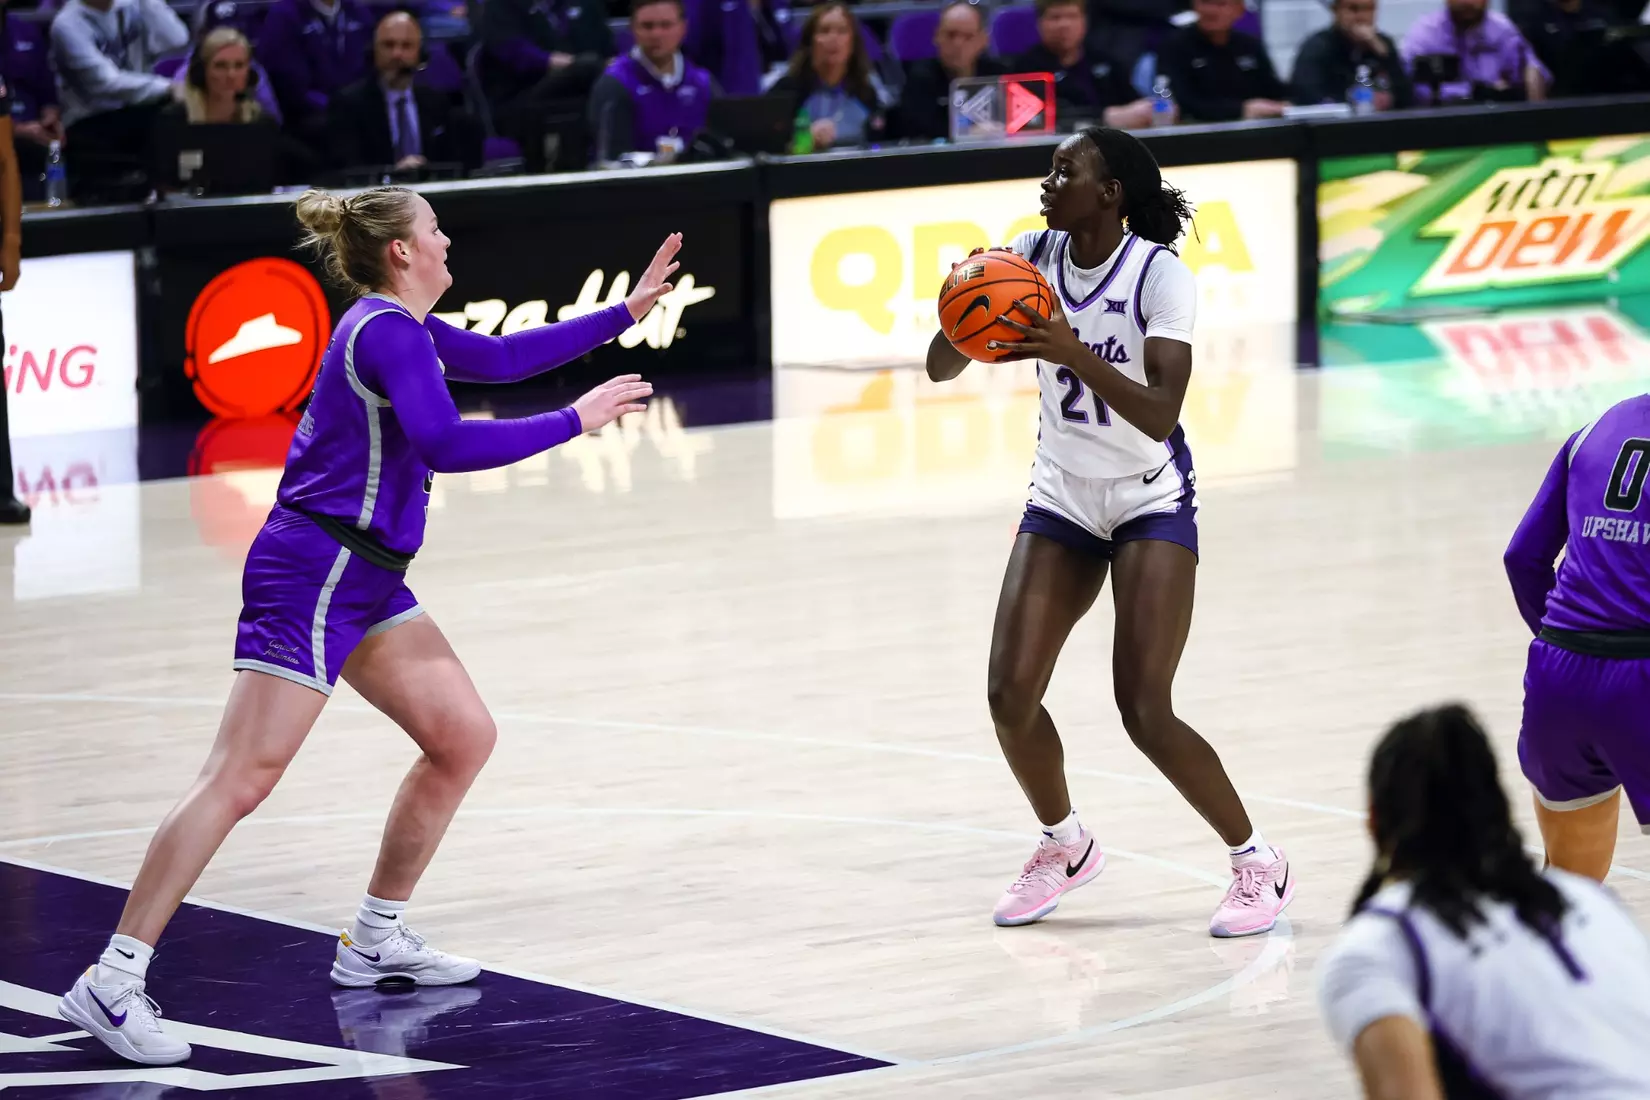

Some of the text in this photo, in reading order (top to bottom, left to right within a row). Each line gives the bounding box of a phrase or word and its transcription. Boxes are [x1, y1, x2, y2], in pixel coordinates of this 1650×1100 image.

[810, 200, 1255, 335] QDA
[1056, 365, 1112, 427] 21
[1603, 437, 1650, 513] 0
